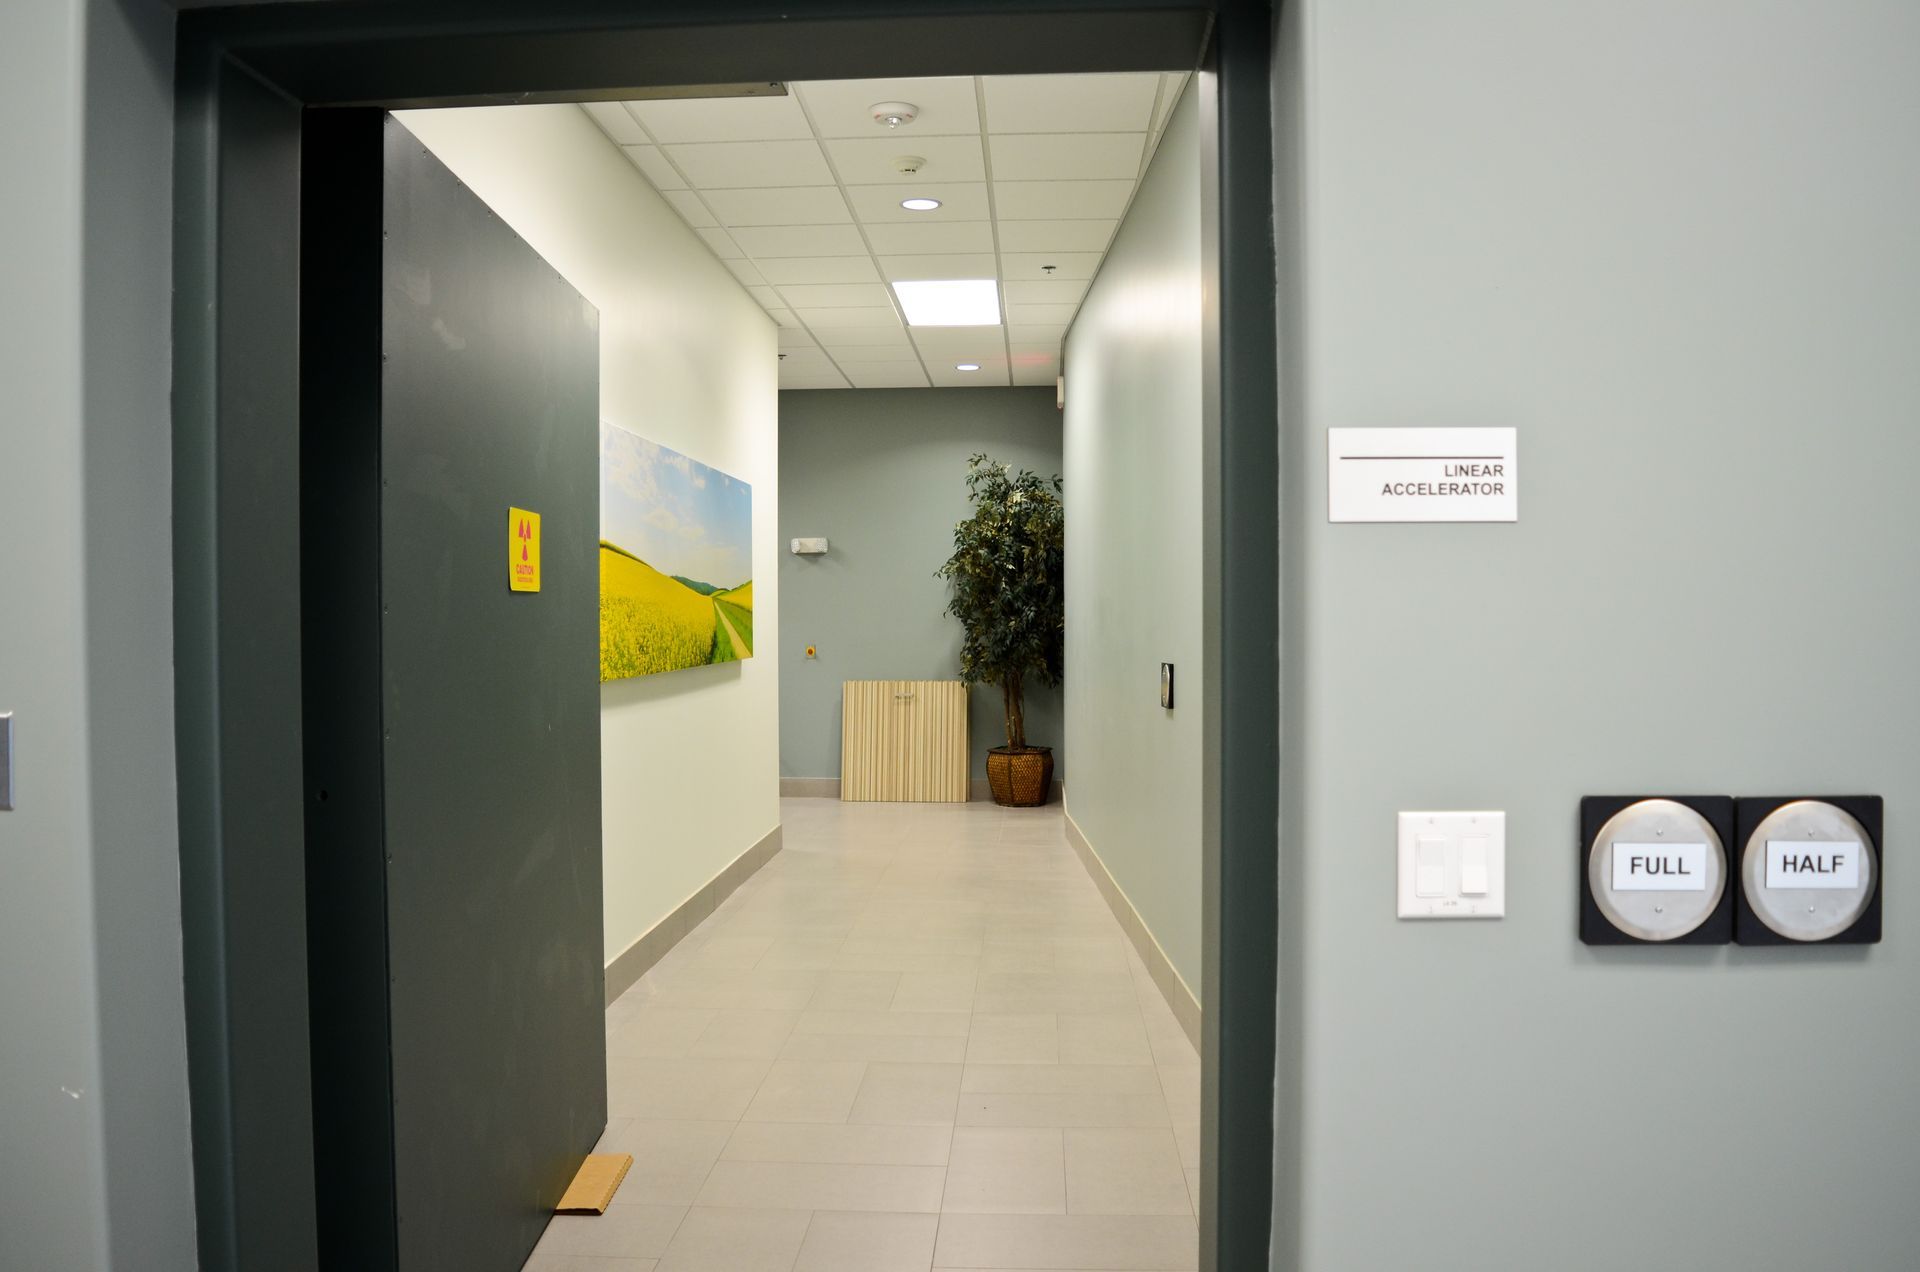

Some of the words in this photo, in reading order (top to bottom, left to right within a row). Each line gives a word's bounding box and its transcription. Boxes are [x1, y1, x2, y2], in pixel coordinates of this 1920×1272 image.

[1444, 464, 1504, 477] LINEAR
[1381, 483, 1504, 496] ACCELERATOR
[1630, 856, 1691, 875] FULL
[1782, 854, 1845, 873] HALF
